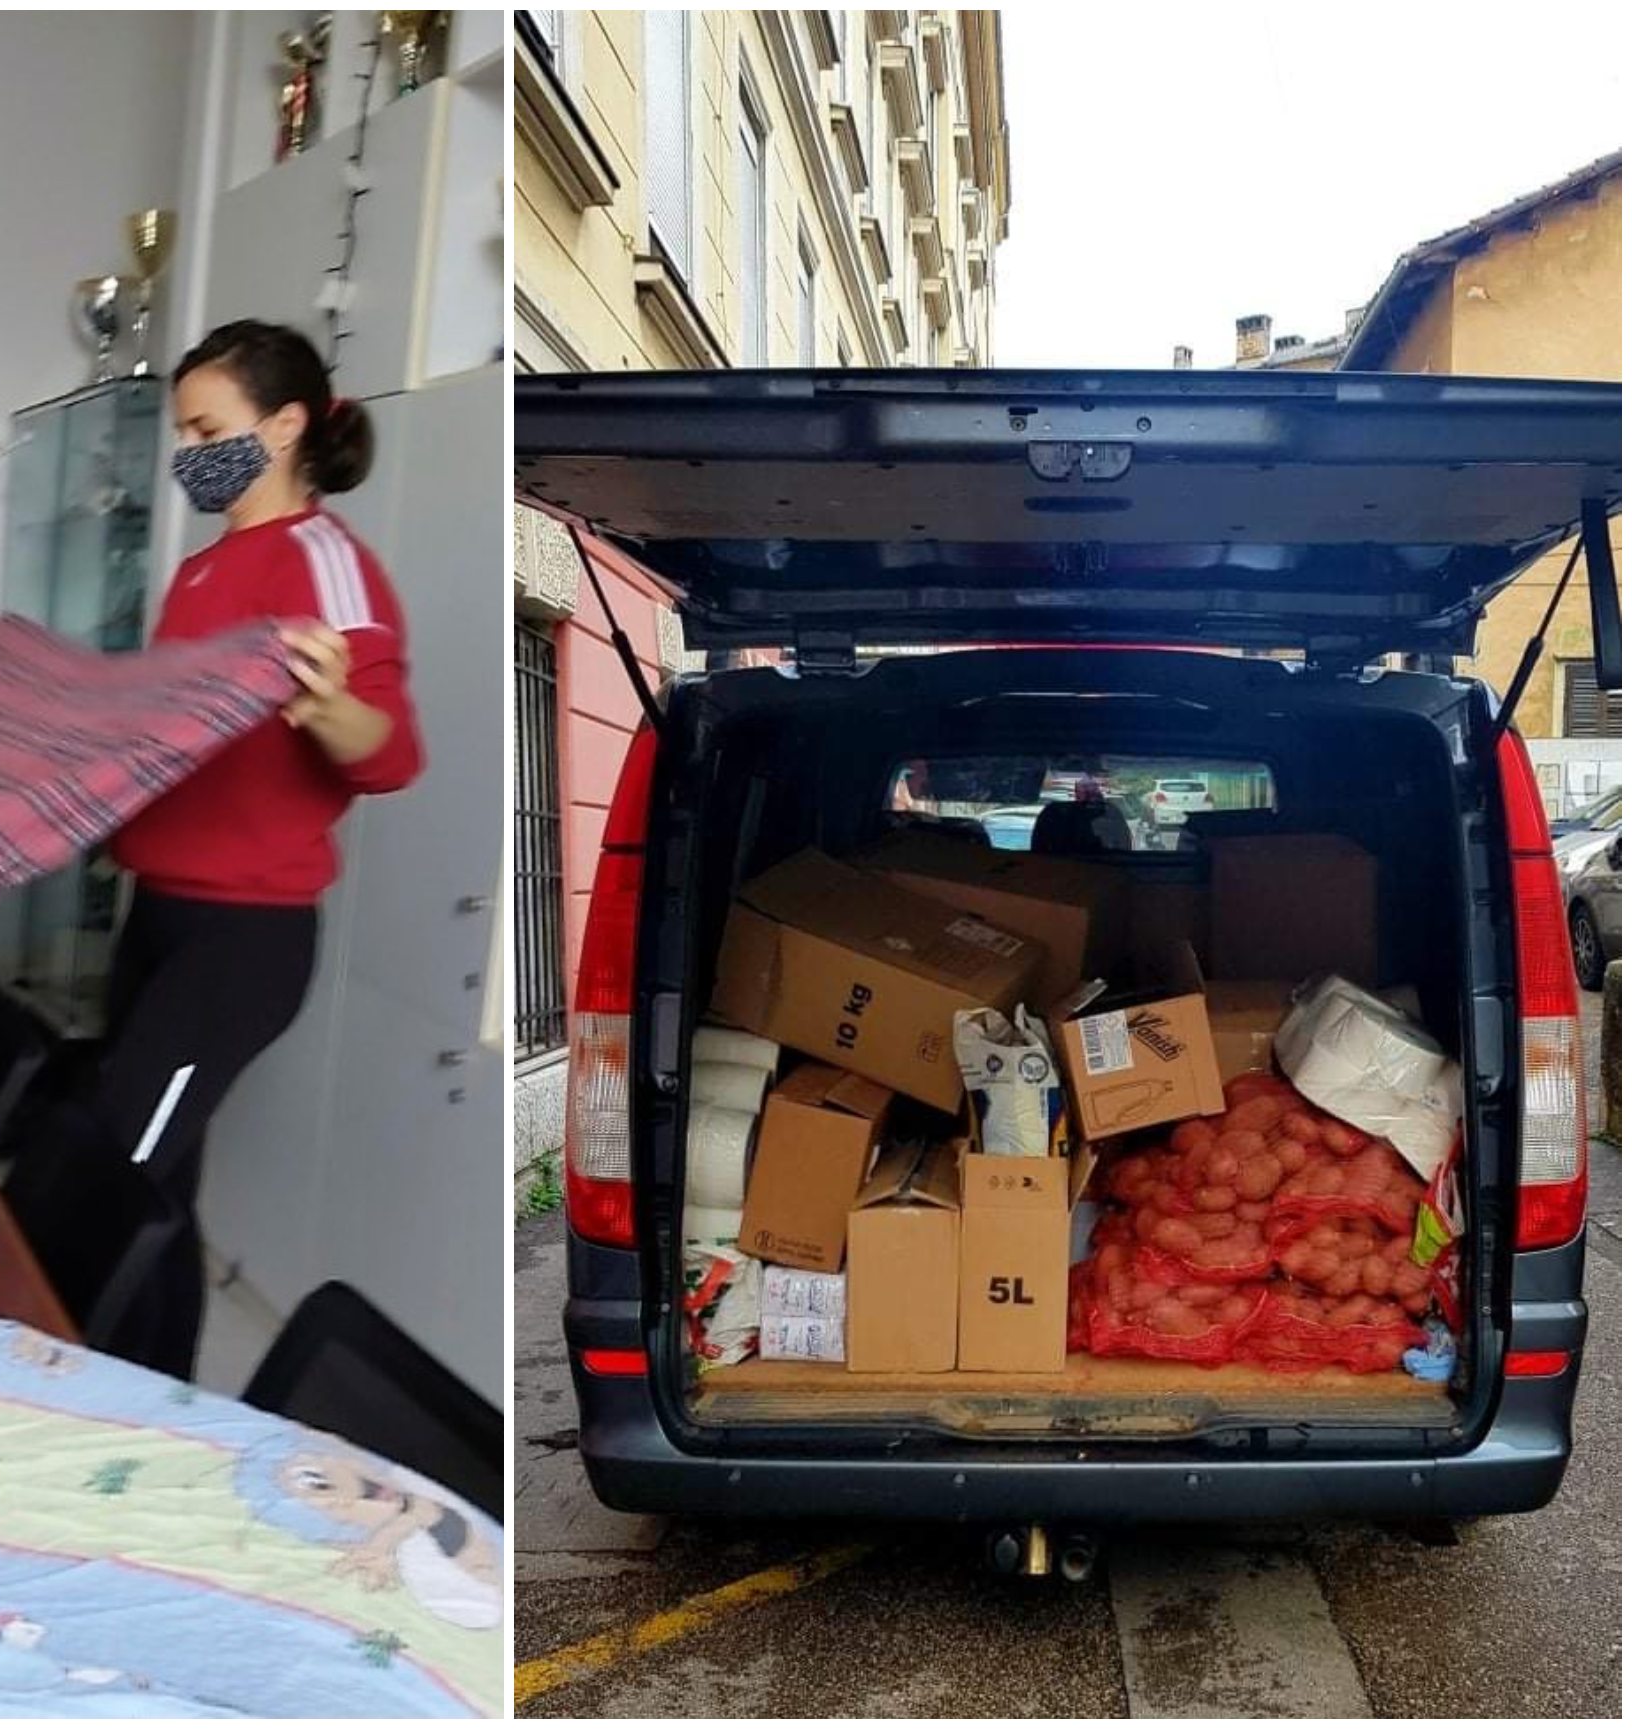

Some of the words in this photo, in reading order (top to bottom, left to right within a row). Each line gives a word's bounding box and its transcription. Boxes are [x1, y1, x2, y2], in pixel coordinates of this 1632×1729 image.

[843, 983, 873, 1016] kg
[836, 1022, 858, 1049] 10
[1128, 1011, 1185, 1060] Vanish
[988, 1276, 1034, 1305] 5L
